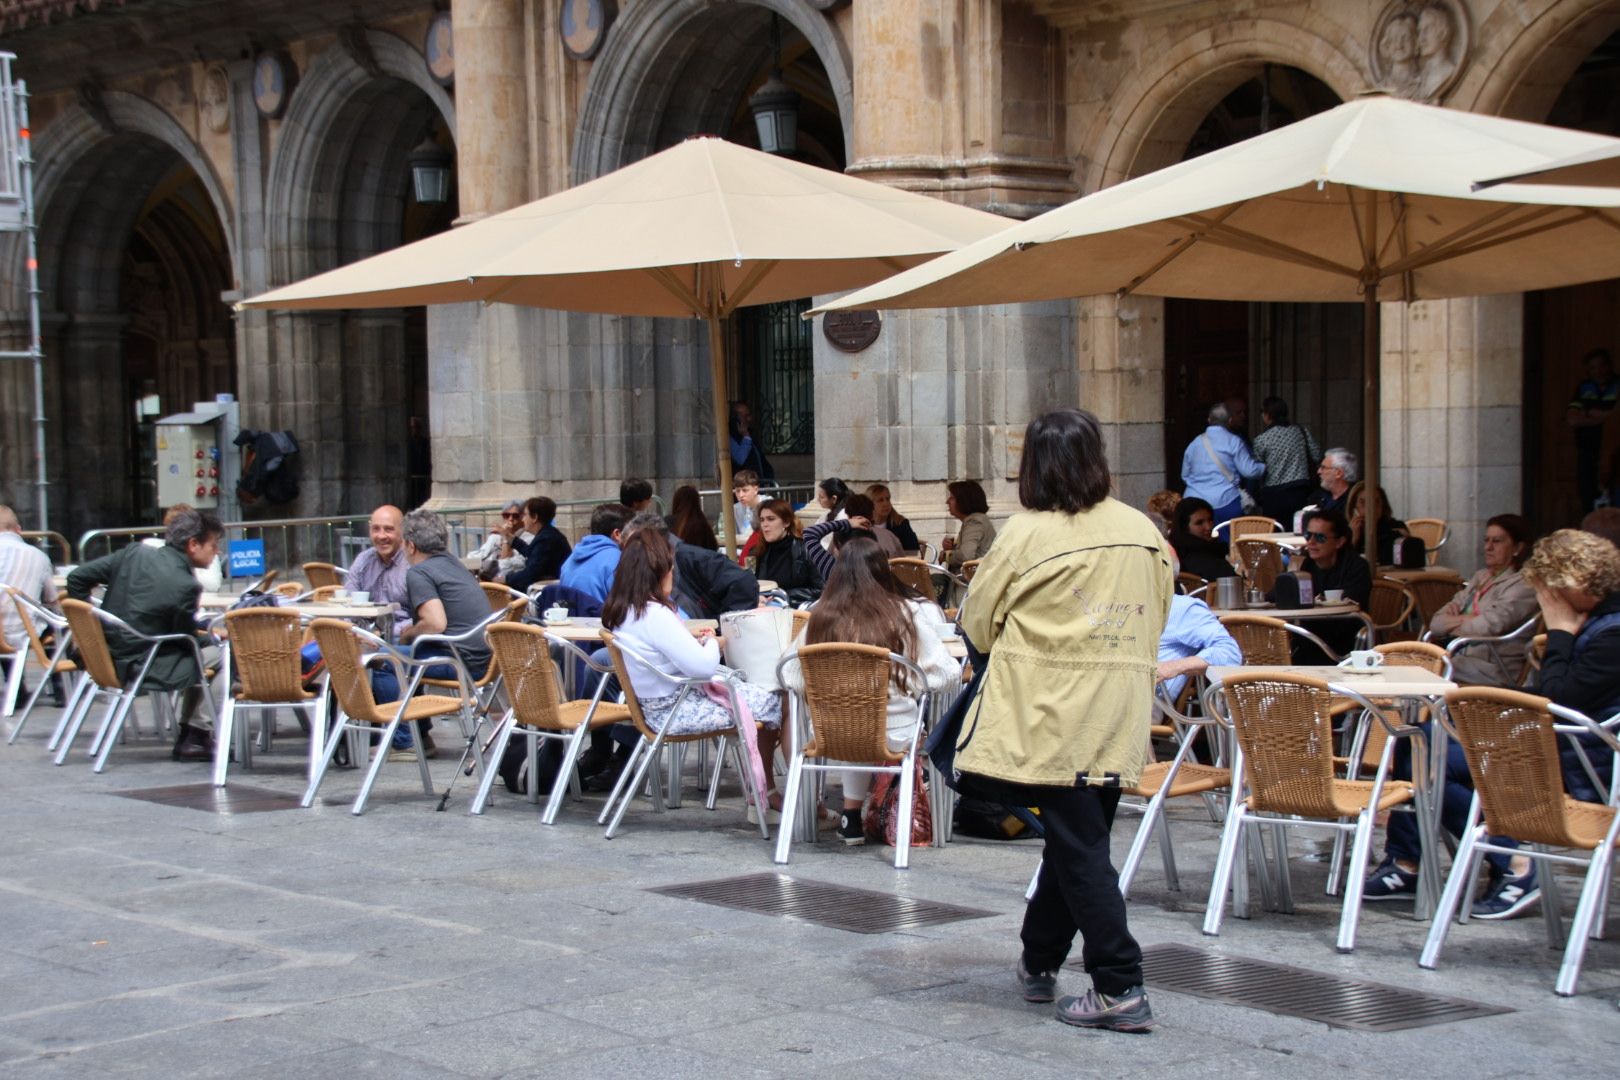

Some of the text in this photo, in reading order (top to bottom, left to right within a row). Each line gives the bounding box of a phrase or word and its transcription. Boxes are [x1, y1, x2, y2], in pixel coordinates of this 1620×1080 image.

[234, 559, 260, 568] LOCAL
[1382, 873, 1405, 890] N
[1498, 885, 1524, 902] N
